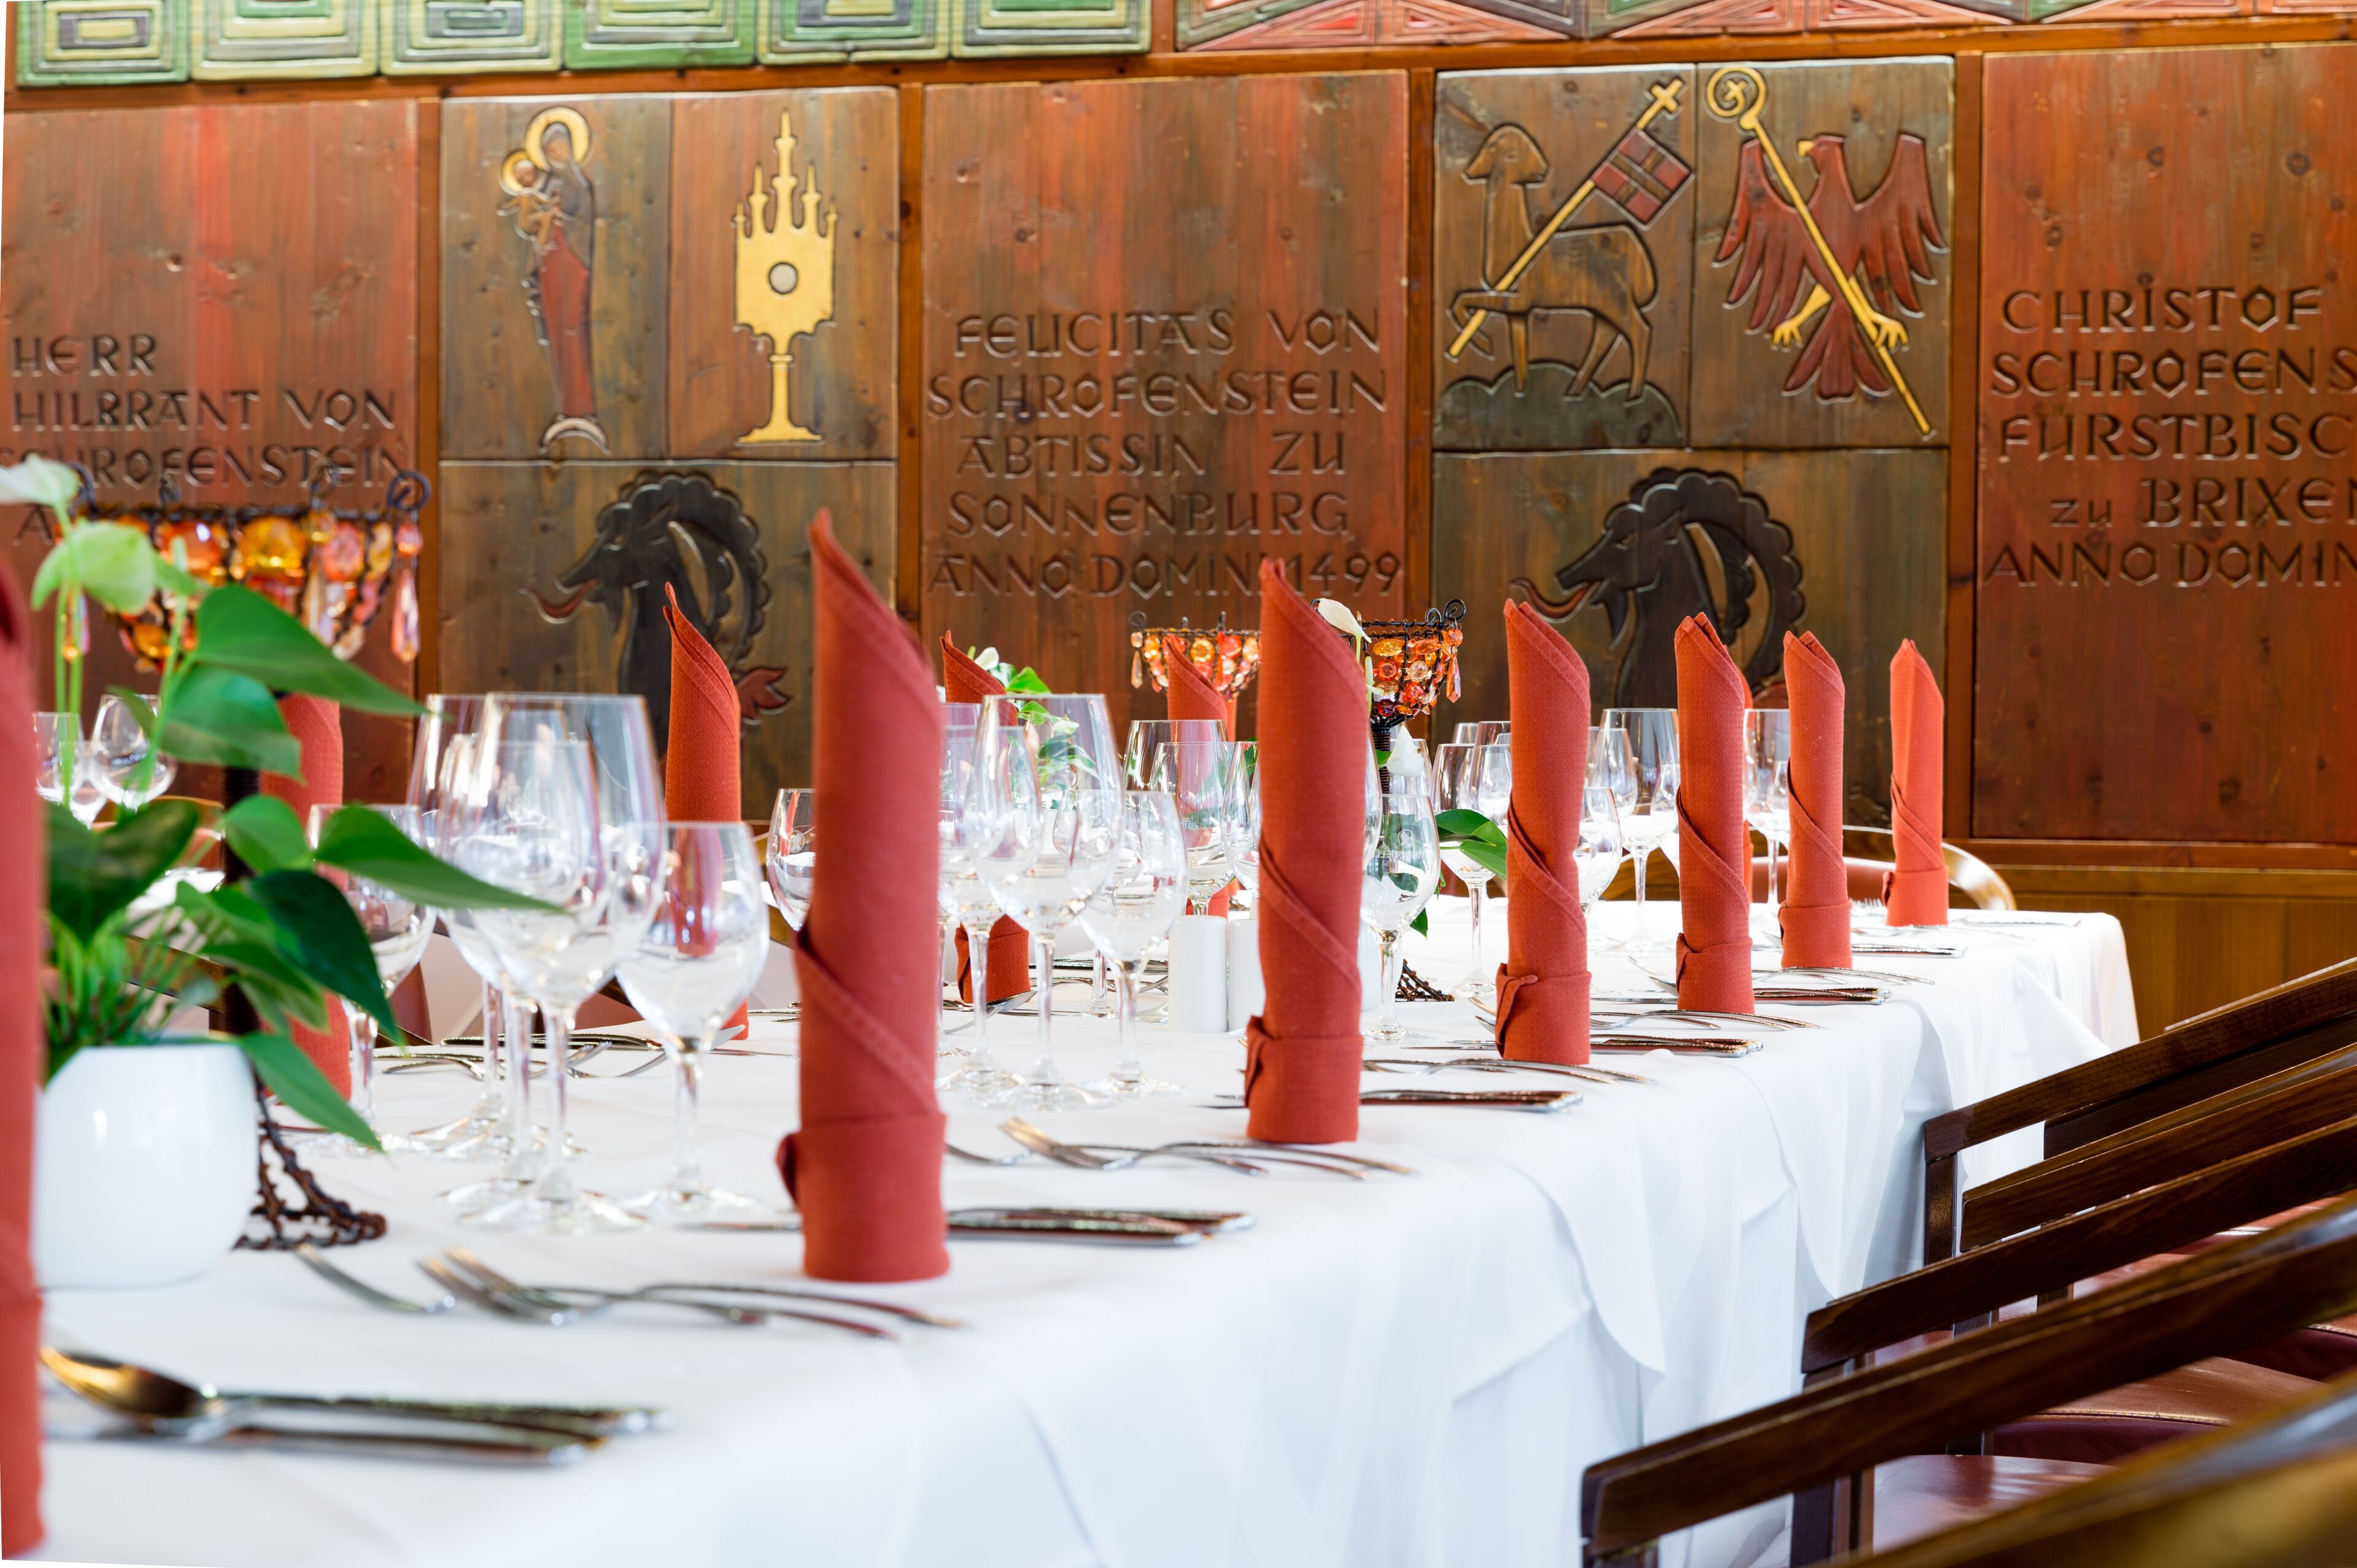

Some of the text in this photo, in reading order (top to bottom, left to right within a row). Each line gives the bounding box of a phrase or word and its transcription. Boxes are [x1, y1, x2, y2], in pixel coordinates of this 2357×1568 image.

[954, 309, 1380, 357] FELICITAS VON
[2002, 285, 2324, 333] CHRISTOF
[12, 334, 156, 377] HERR
[1991, 347, 2357, 399] SCHROFENS
[12, 388, 396, 431] HILBRANT VON
[927, 371, 1387, 420] SCHROFENSTEIN
[1, 446, 411, 490] ROFENSTEIN
[956, 431, 1345, 479] ABTISSIN ZU
[946, 492, 1349, 537] SONNENBURG
[2141, 476, 2357, 528] BRIXE
[927, 552, 1404, 606] ANNO DOMIN 1499
[1983, 541, 2158, 587] ANNO
